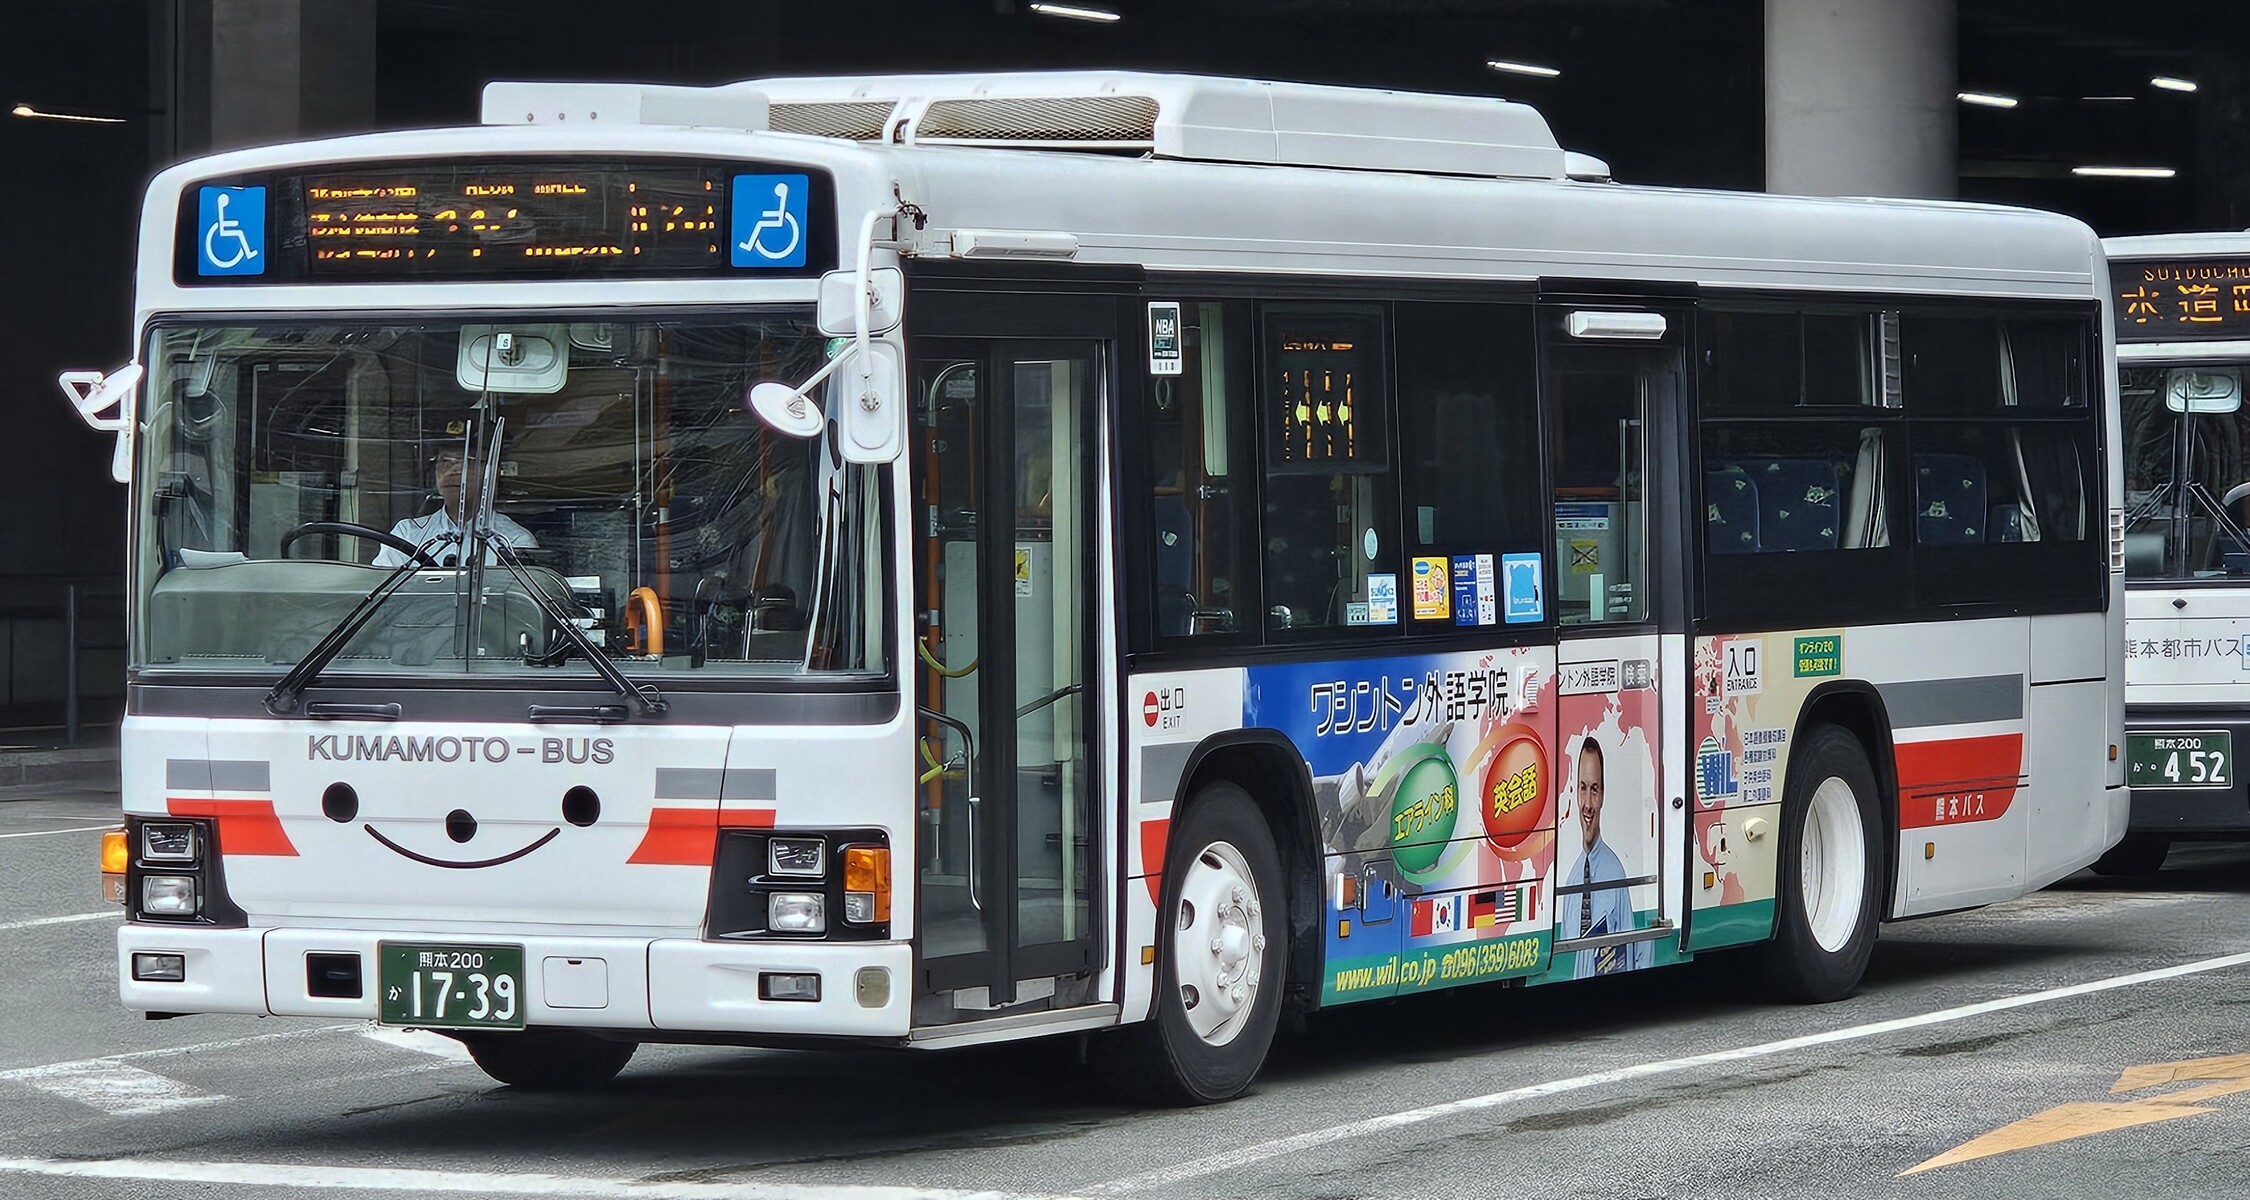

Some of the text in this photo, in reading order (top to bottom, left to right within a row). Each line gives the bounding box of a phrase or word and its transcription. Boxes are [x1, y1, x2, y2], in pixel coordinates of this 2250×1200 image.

[1727, 647, 1756, 678] 入口
[1160, 687, 1184, 711] 出口
[1726, 677, 1758, 693] ENTRANCE
[1311, 667, 1510, 737] ワシントン外語学院
[1162, 715, 1181, 729] EXIT
[308, 735, 510, 763] KUMAMOTO
[541, 737, 615, 765] BUS
[2154, 738, 2202, 750] 熊本200
[1700, 751, 1739, 796] WIL
[1493, 762, 1538, 819] 英会話
[1393, 782, 1456, 841] エアライン科
[1934, 793, 1985, 821] 熊本バス
[419, 951, 484, 969] 熊本200
[1335, 952, 1437, 992] www.wil.co.jp
[388, 970, 516, 1021] か 17-39
